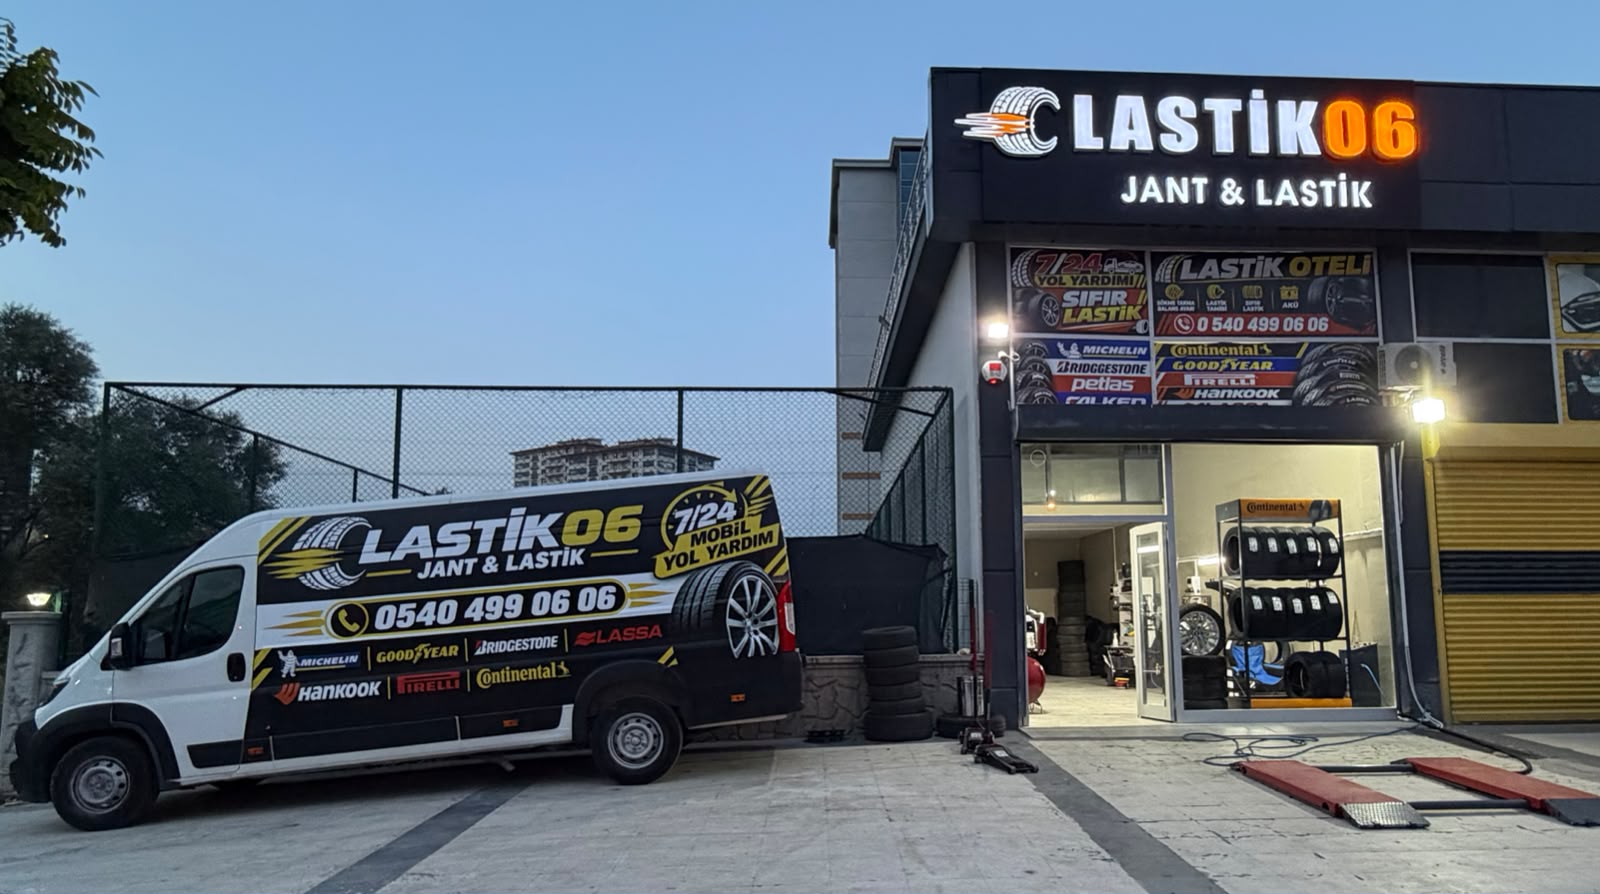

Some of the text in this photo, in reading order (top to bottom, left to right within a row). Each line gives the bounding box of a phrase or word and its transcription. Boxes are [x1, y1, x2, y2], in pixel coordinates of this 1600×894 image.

[1121, 173, 1374, 209] JANT & LASTİK
[1035, 252, 1102, 275] 7/24
[1038, 275, 1067, 287] YOL
[1062, 290, 1128, 307] SIFIR
[1282, 301, 1299, 309] AKÜ
[1197, 317, 1329, 332] 0 540 499 06 06
[1083, 344, 1148, 355] MICHELIN
[1170, 343, 1259, 357] Continental
[1172, 359, 1274, 372] GOODYEAR
[1071, 377, 1135, 392] petlas
[1184, 374, 1257, 386] PIRELLI
[1247, 502, 1297, 512] Continental
[674, 500, 737, 536] 7/24
[663, 530, 774, 571] YOL YARDIM
[417, 547, 586, 580] JANT & LASTİK
[374, 585, 617, 631] 0540 499 06 06
[596, 624, 663, 645] LASSA
[376, 643, 459, 664] GOODYEAR
[474, 635, 559, 656] BRIDGESTONE
[299, 654, 359, 668] MICHELIN
[397, 671, 461, 695] PIRELLI
[476, 662, 557, 689] Continental
